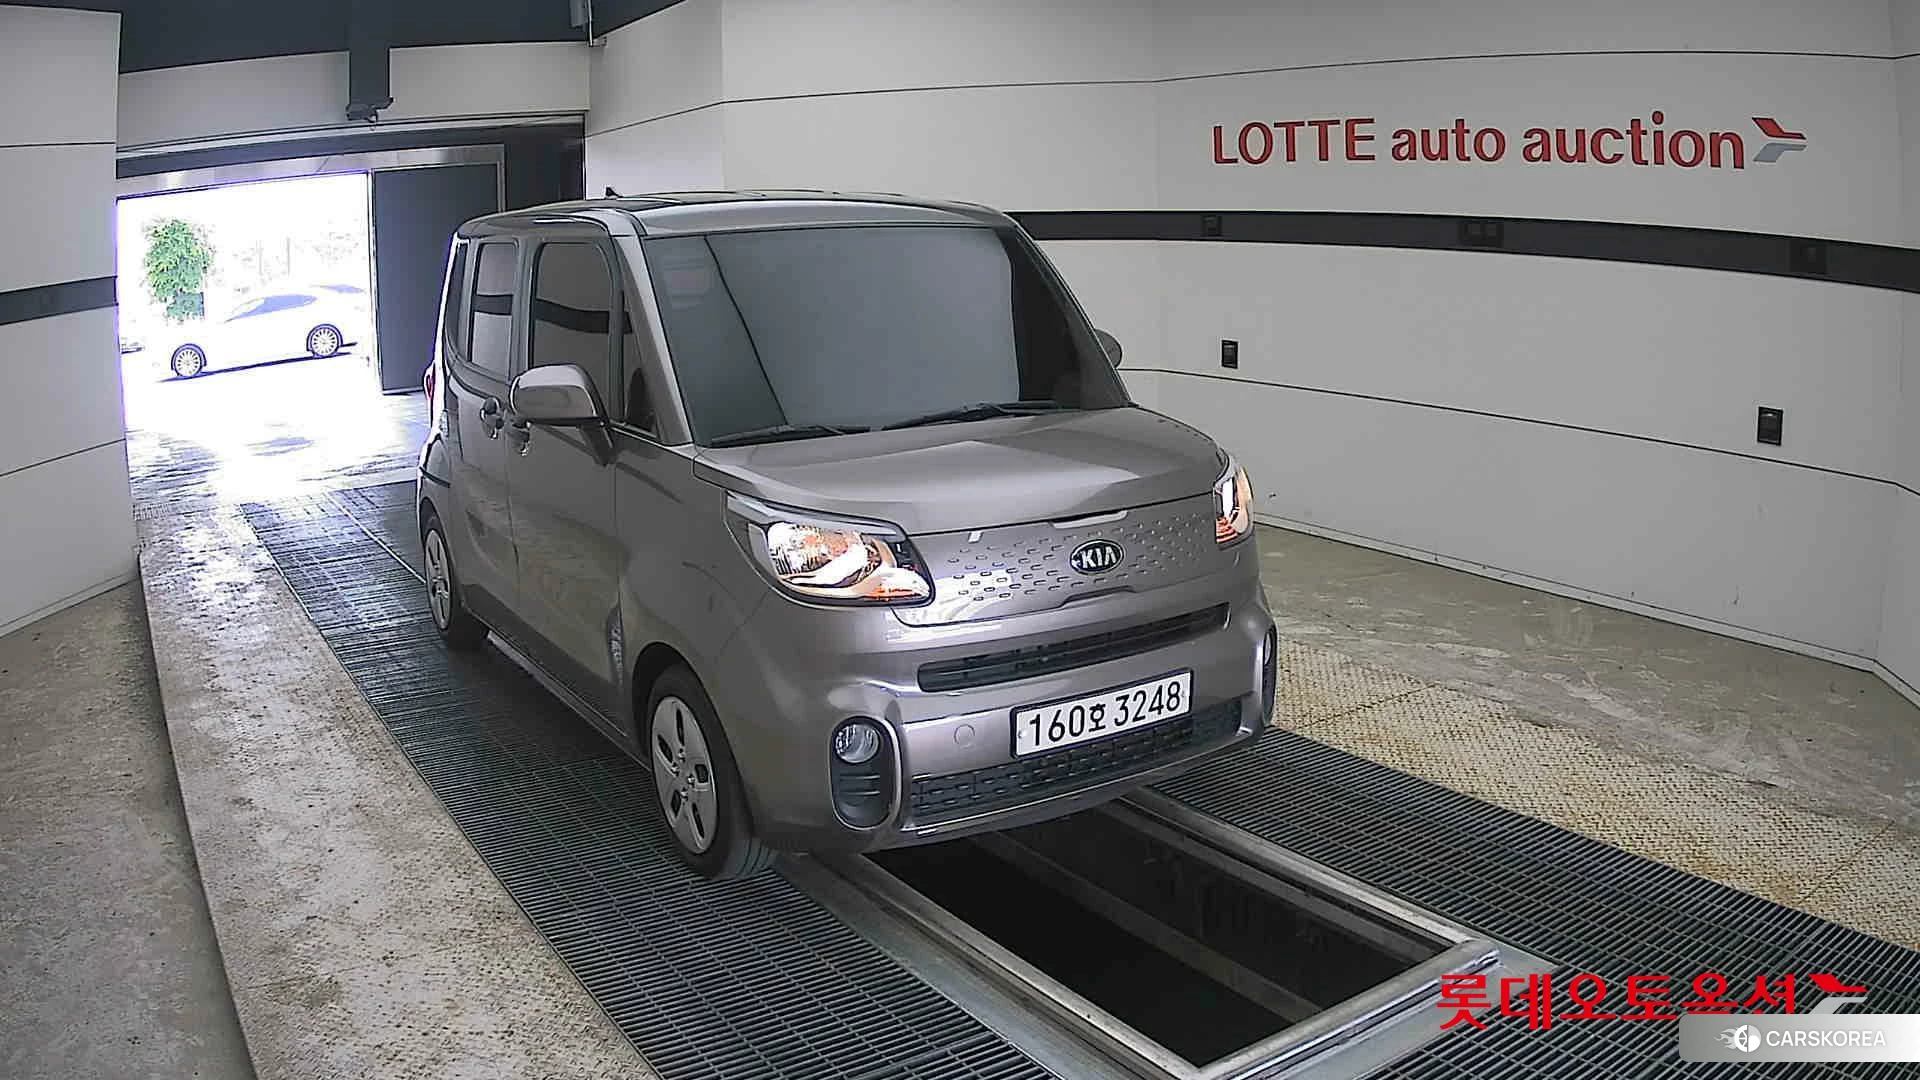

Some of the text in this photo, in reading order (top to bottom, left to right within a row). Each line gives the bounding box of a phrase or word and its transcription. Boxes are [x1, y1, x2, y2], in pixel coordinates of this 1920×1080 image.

[1212, 110, 1745, 170] LOTTE auto auction
[1080, 546, 1117, 569] KIA
[1029, 681, 1181, 745] 160호 3248
